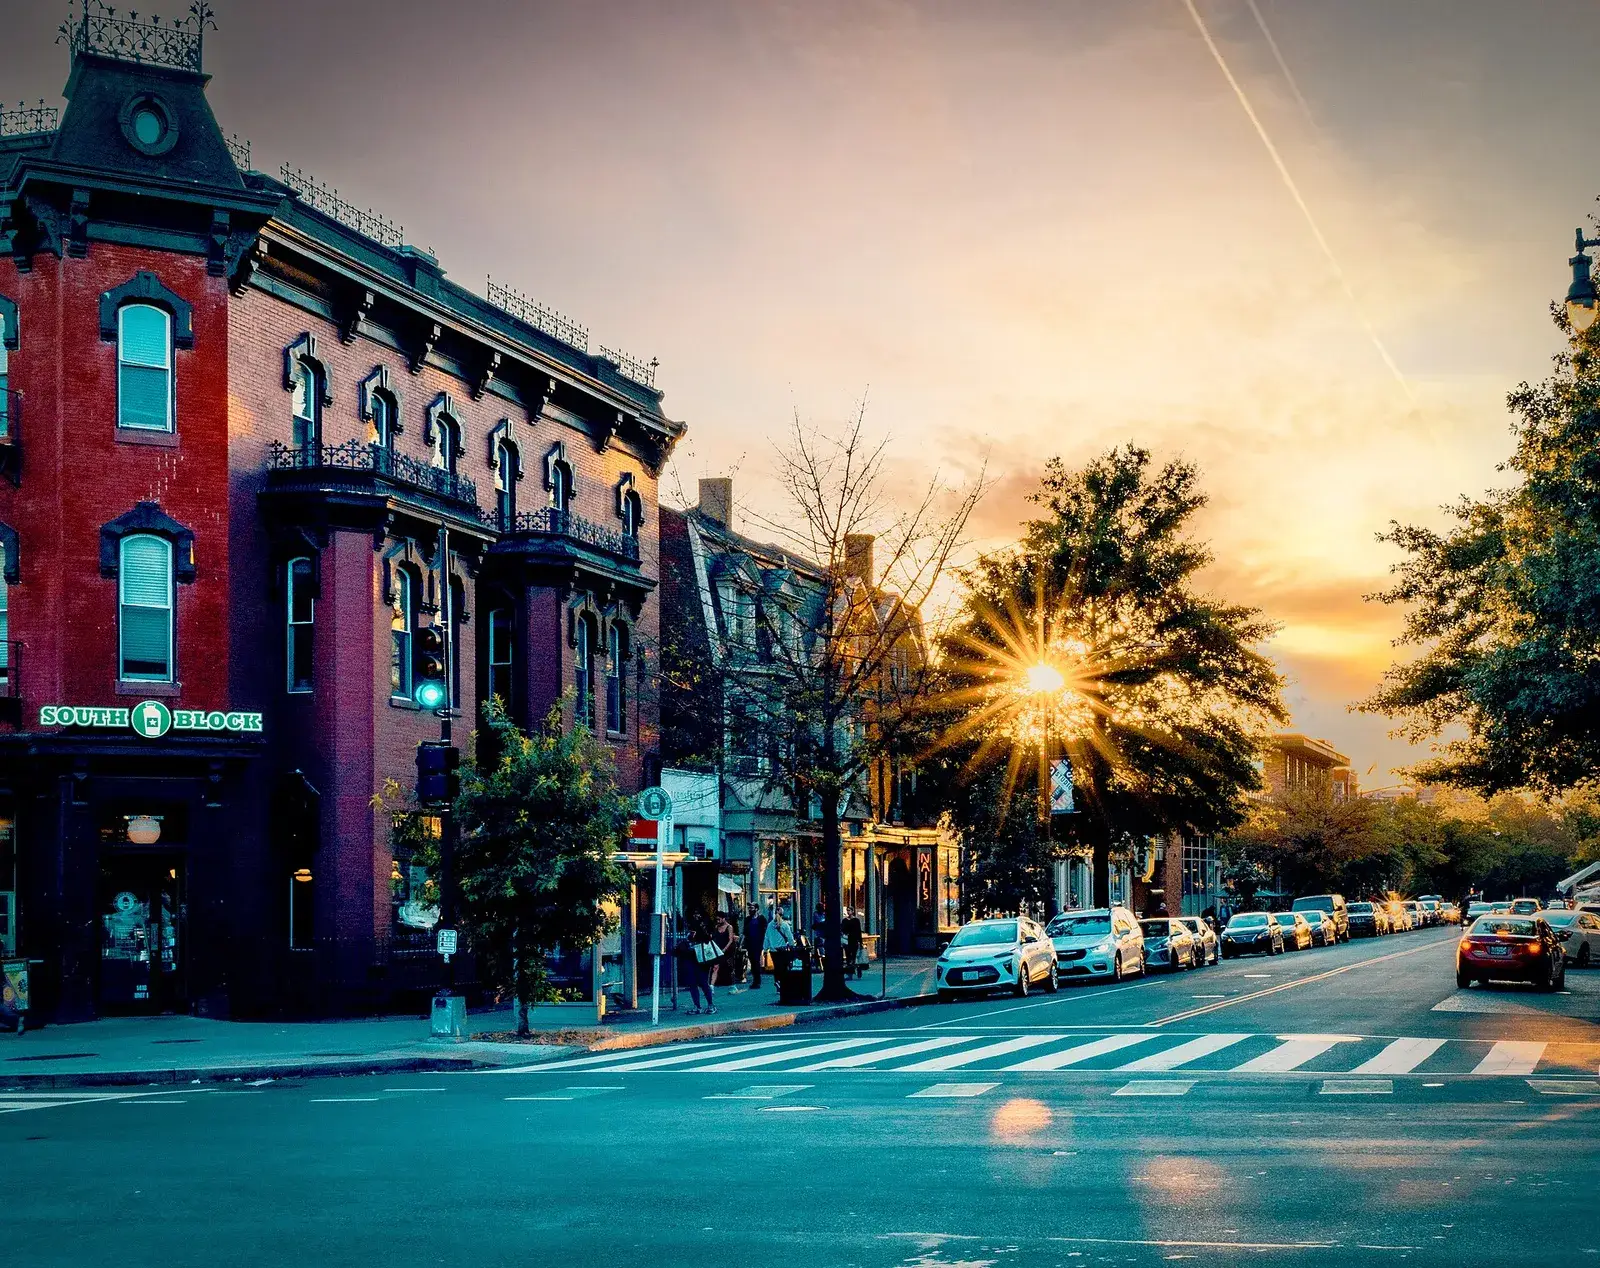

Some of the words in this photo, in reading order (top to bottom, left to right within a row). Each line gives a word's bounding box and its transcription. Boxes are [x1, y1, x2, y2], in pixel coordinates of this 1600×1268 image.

[40, 706, 129, 727] SOUTH
[174, 710, 263, 731] BLOCK
[920, 853, 930, 900] NAILS
